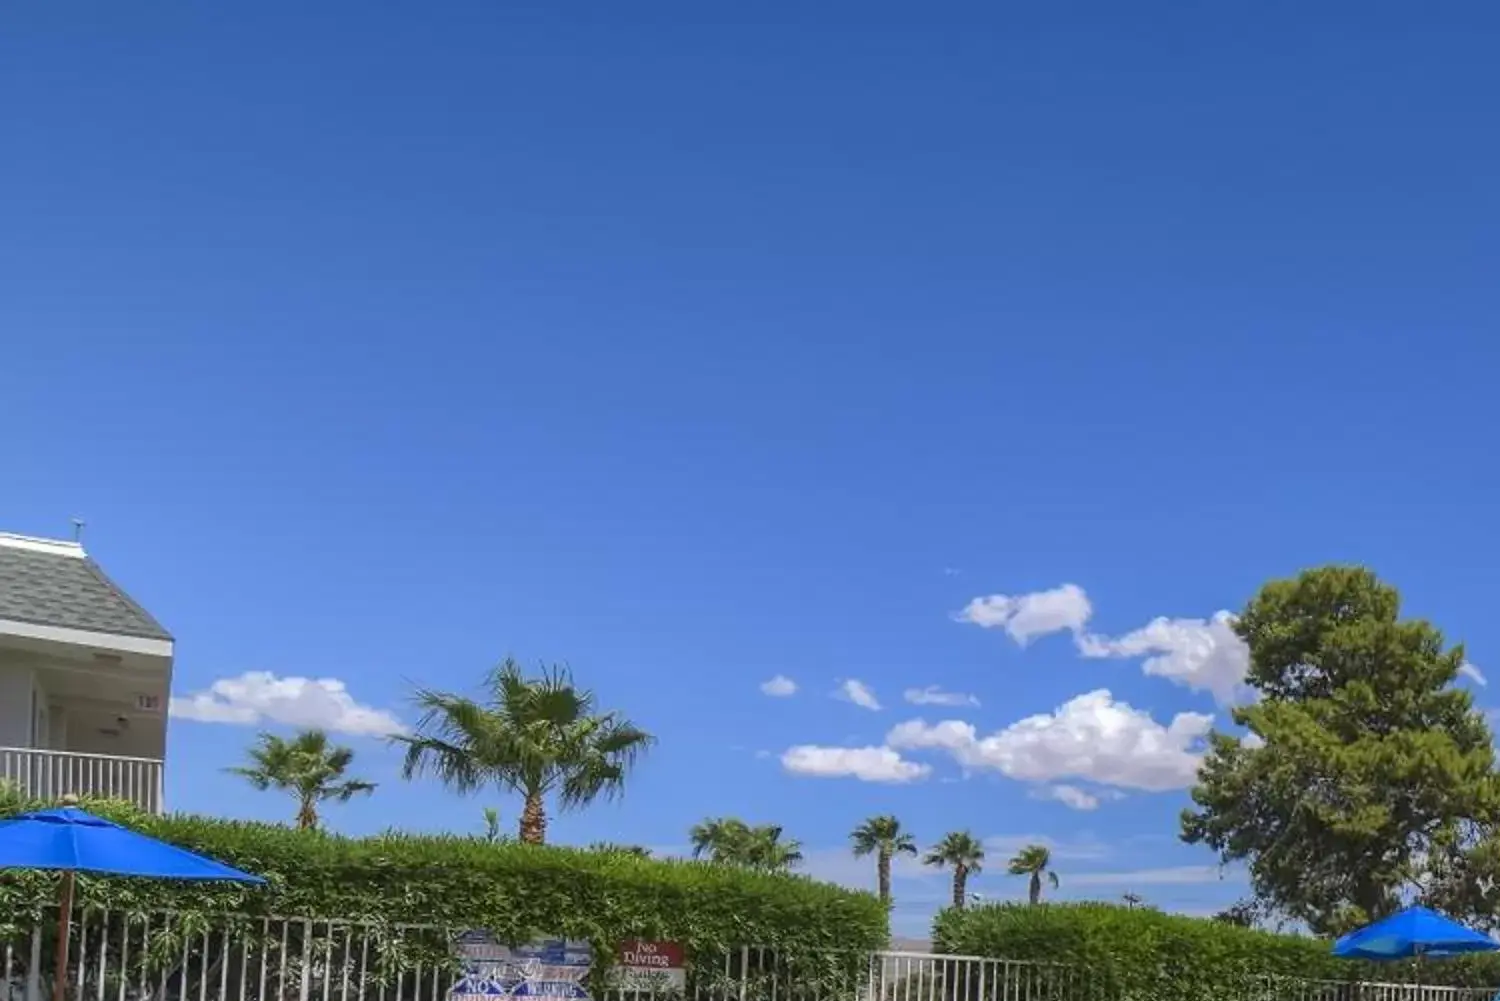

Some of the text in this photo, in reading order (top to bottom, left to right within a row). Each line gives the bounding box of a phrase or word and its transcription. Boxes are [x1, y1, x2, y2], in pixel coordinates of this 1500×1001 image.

[637, 942, 657, 953] No
[623, 951, 669, 967] Diving
[466, 977, 488, 994] NO
